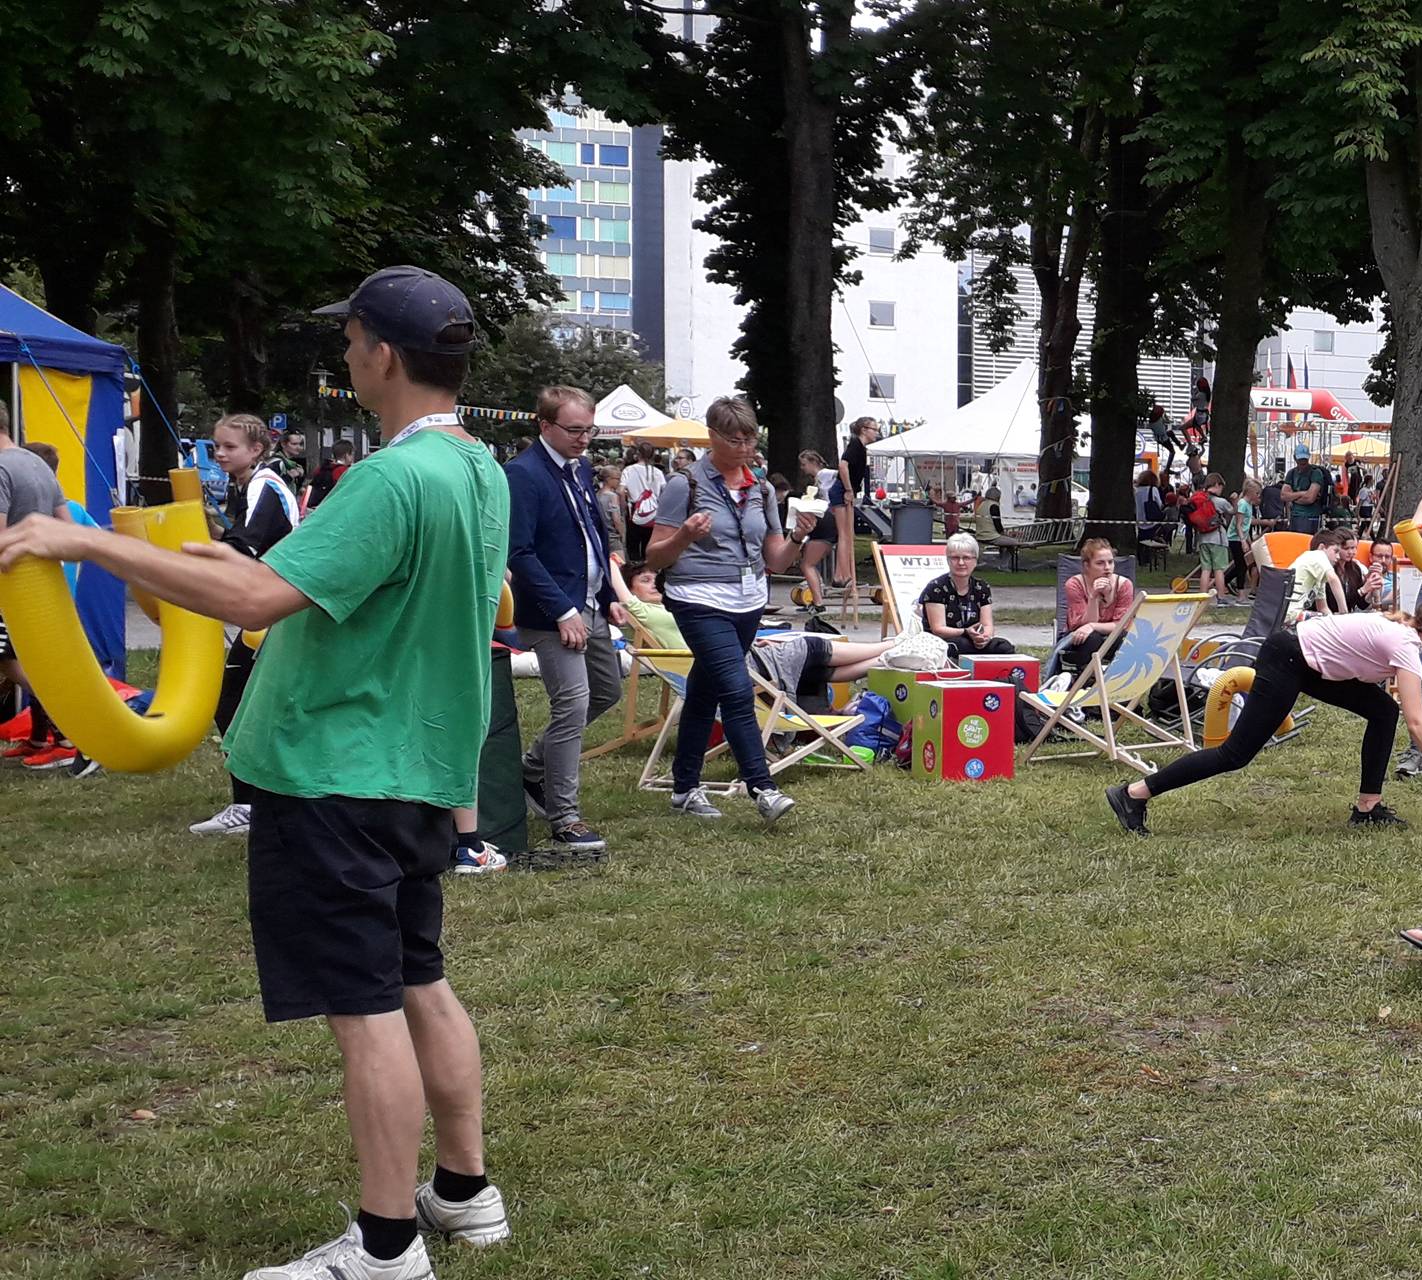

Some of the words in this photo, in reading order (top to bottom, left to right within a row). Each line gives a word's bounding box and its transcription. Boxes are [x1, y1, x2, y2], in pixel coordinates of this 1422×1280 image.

[1260, 396, 1291, 407] ZIEL
[273, 415, 283, 427] P
[900, 557, 930, 566] WTJ
